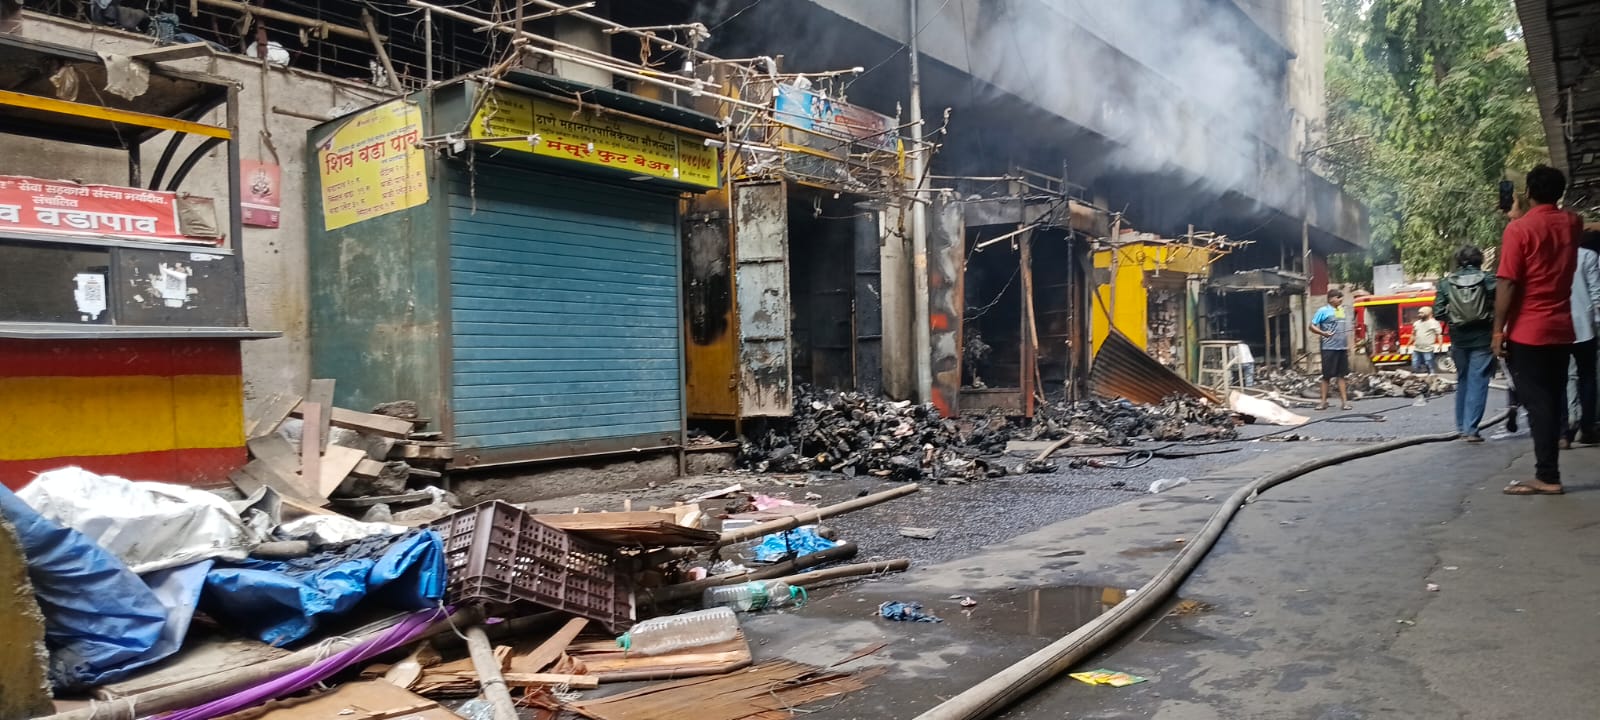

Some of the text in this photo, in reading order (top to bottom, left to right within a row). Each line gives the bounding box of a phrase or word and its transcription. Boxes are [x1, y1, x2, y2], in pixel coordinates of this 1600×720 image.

[325, 151, 354, 175] शिव
[358, 140, 386, 163] वडा
[390, 129, 418, 152] पाव
[596, 149, 629, 164] फुट
[19, 179, 42, 192] सेवा
[45, 183, 89, 197] सहकारी
[33, 206, 158, 234] वडापाव
